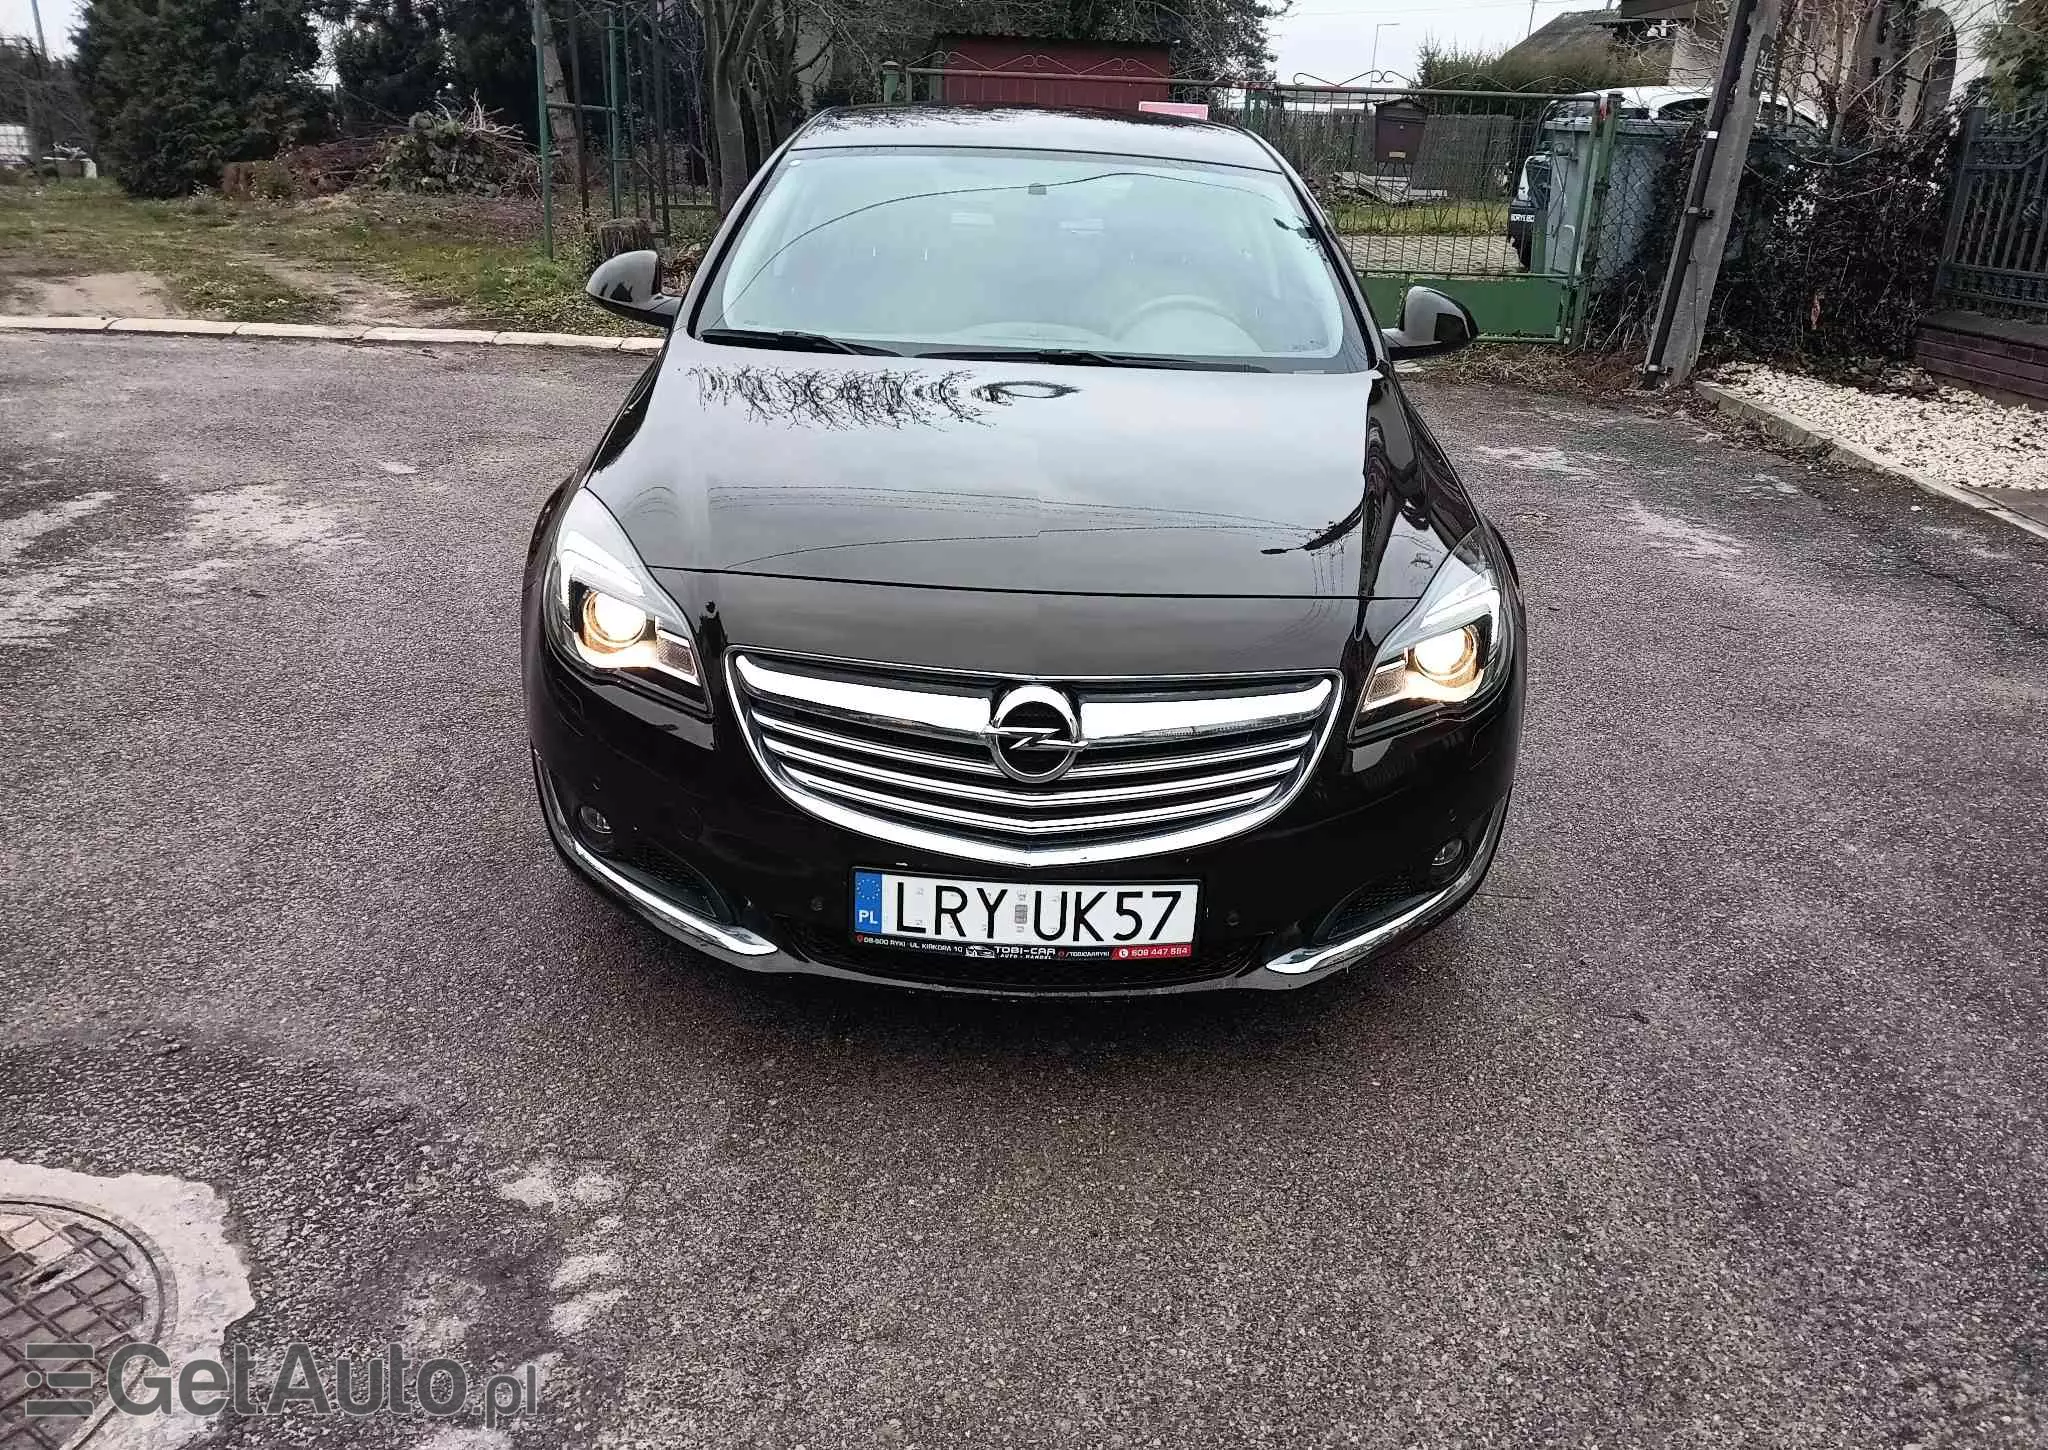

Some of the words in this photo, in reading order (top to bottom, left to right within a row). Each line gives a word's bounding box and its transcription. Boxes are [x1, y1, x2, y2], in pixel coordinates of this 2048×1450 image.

[858, 909, 878, 924] PL
[897, 882, 1008, 939] LRY
[1034, 890, 1181, 941] UK57
[994, 945, 1056, 955] TOBI-CAR
